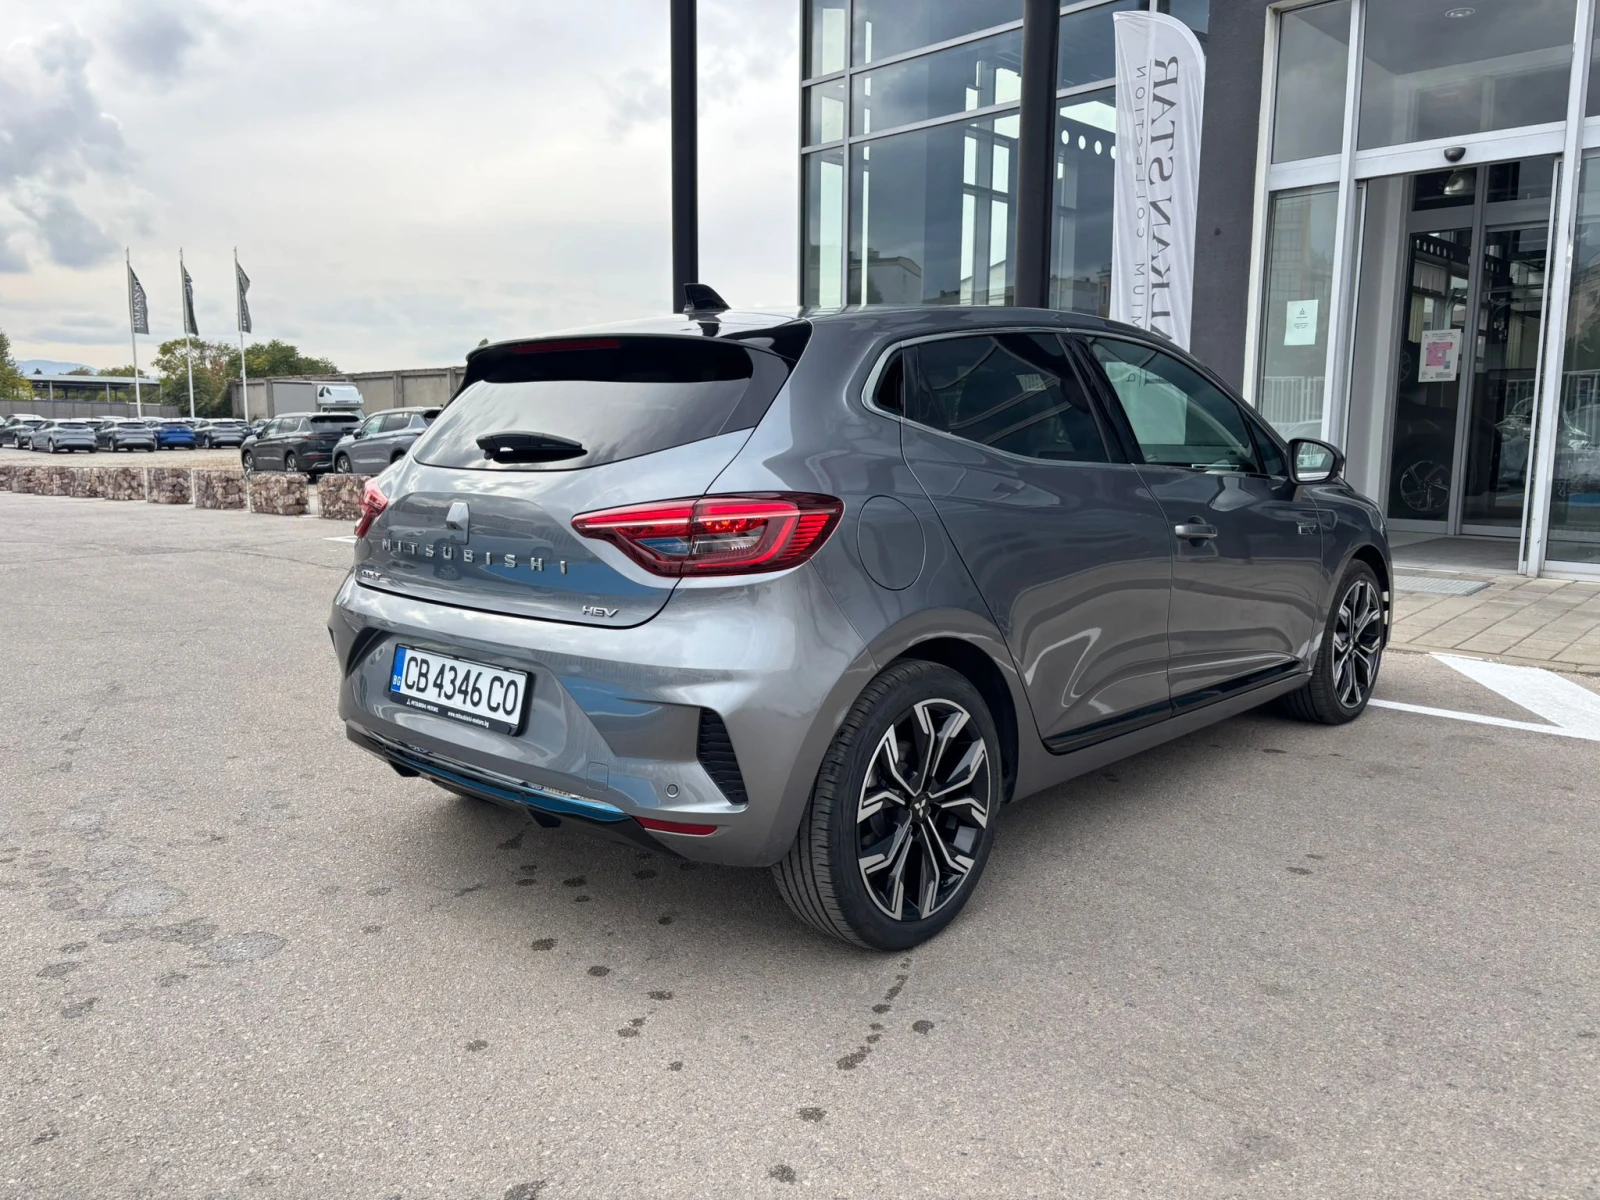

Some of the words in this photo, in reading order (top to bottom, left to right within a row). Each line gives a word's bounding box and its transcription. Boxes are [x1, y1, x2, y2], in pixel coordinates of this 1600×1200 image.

[382, 538, 568, 575] MITSUBISHI
[582, 605, 619, 618] HEV
[392, 675, 402, 686] BG
[432, 664, 483, 708] 4346
